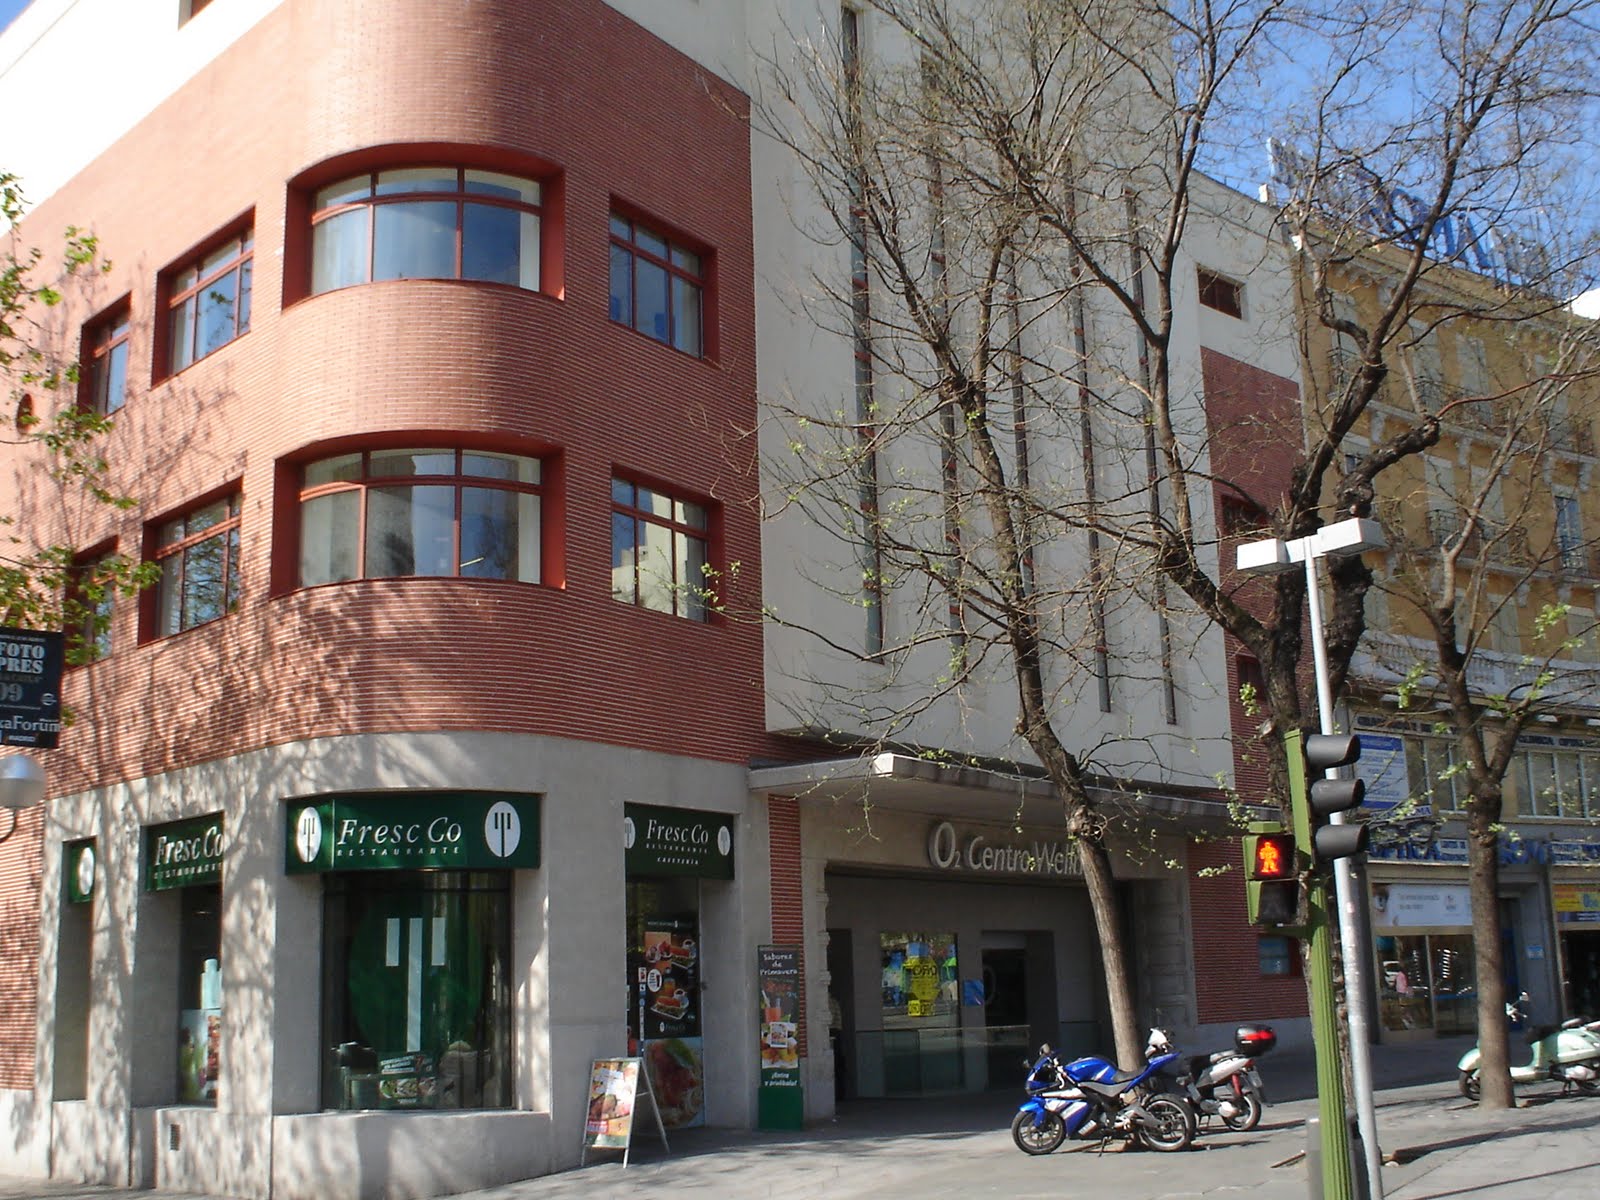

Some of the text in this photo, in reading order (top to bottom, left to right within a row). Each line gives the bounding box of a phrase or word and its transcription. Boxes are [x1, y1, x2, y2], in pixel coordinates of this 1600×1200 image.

[0, 642, 45, 659] FOTO
[0, 658, 44, 674] PRES
[337, 816, 462, 845] Fresc Co
[647, 819, 709, 844] Fresc Co
[154, 825, 224, 866] Fresc Co
[336, 846, 460, 857] RESTAURANTE
[967, 835, 1030, 873] Centro
